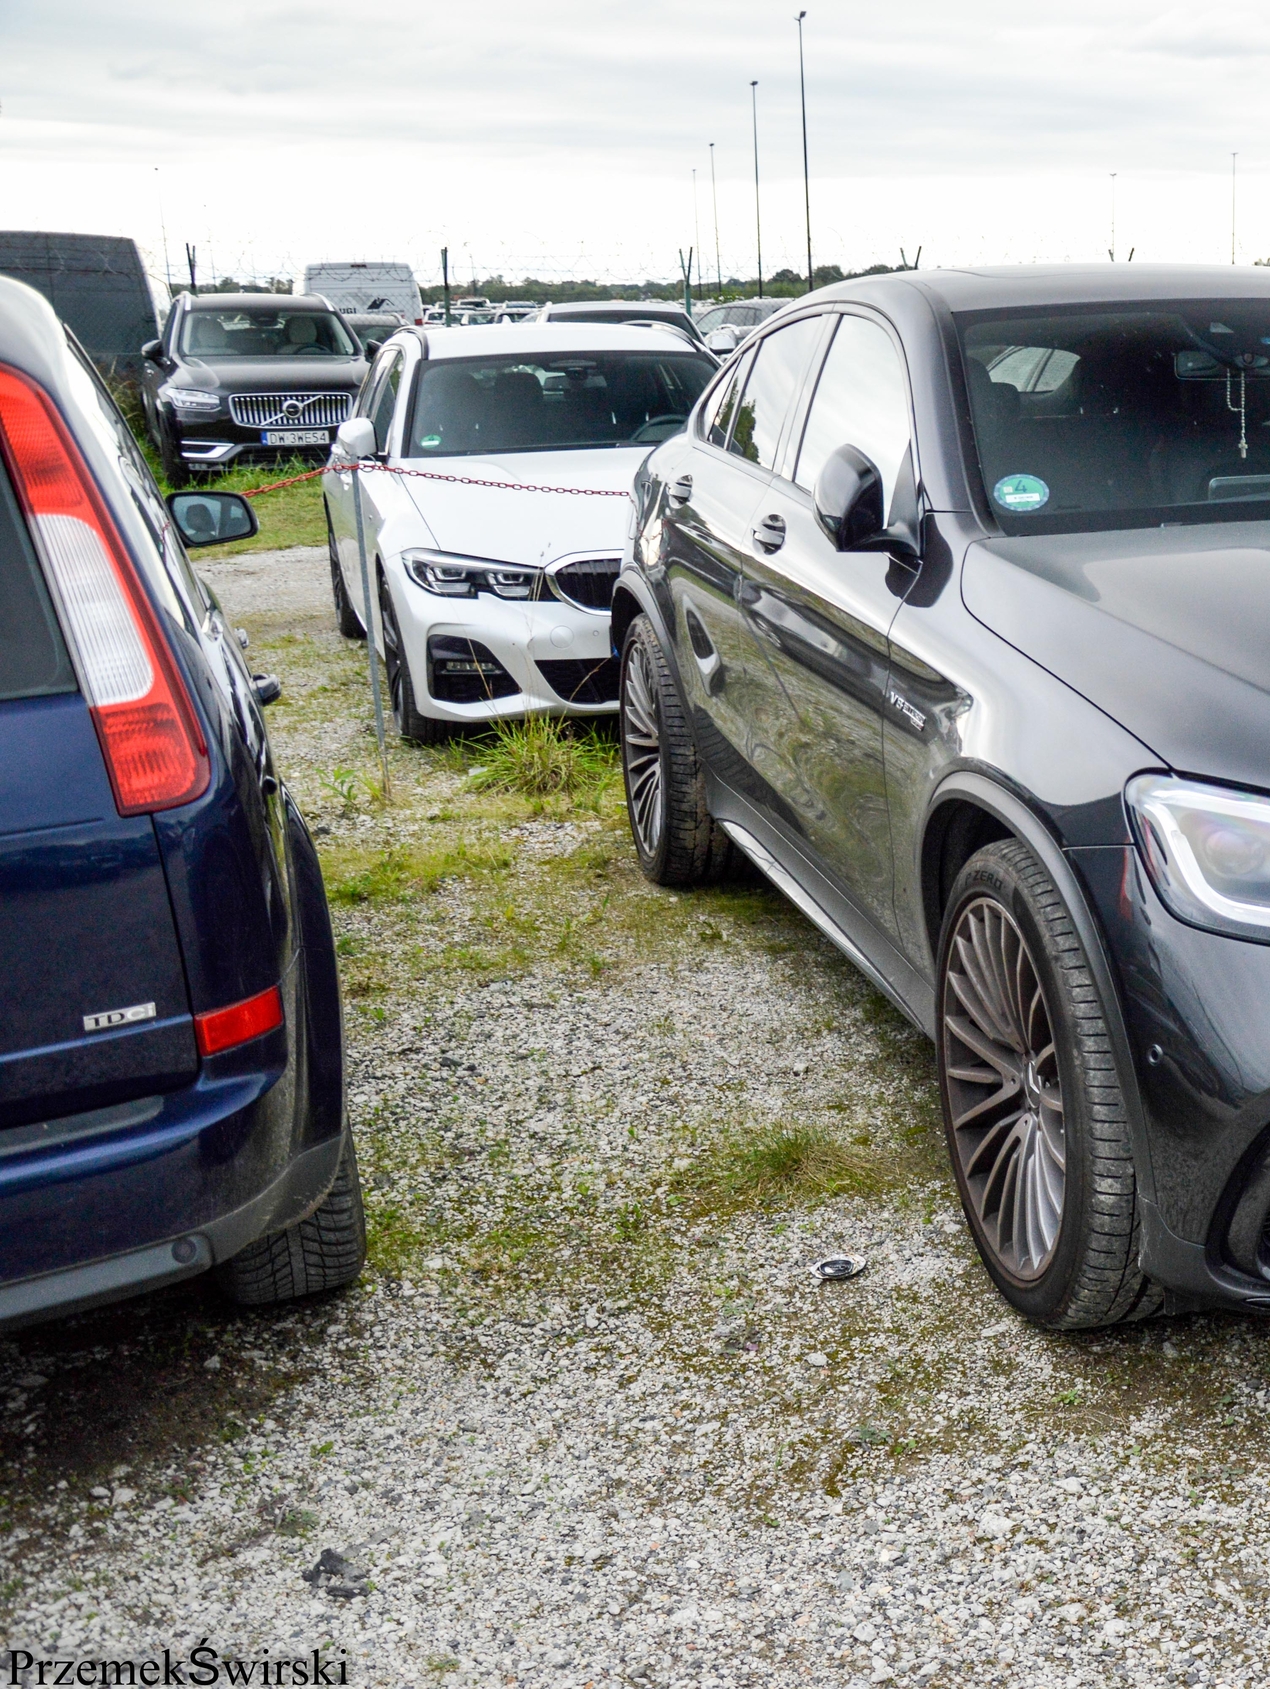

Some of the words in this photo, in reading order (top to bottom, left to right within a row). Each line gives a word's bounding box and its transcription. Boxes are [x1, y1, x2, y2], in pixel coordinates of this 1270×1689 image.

[269, 433, 285, 444] DW
[290, 432, 326, 444] 3WE54
[1014, 479, 1027, 493] 4
[972, 869, 1003, 891] ZERO
[88, 1005, 154, 1027] TDCi
